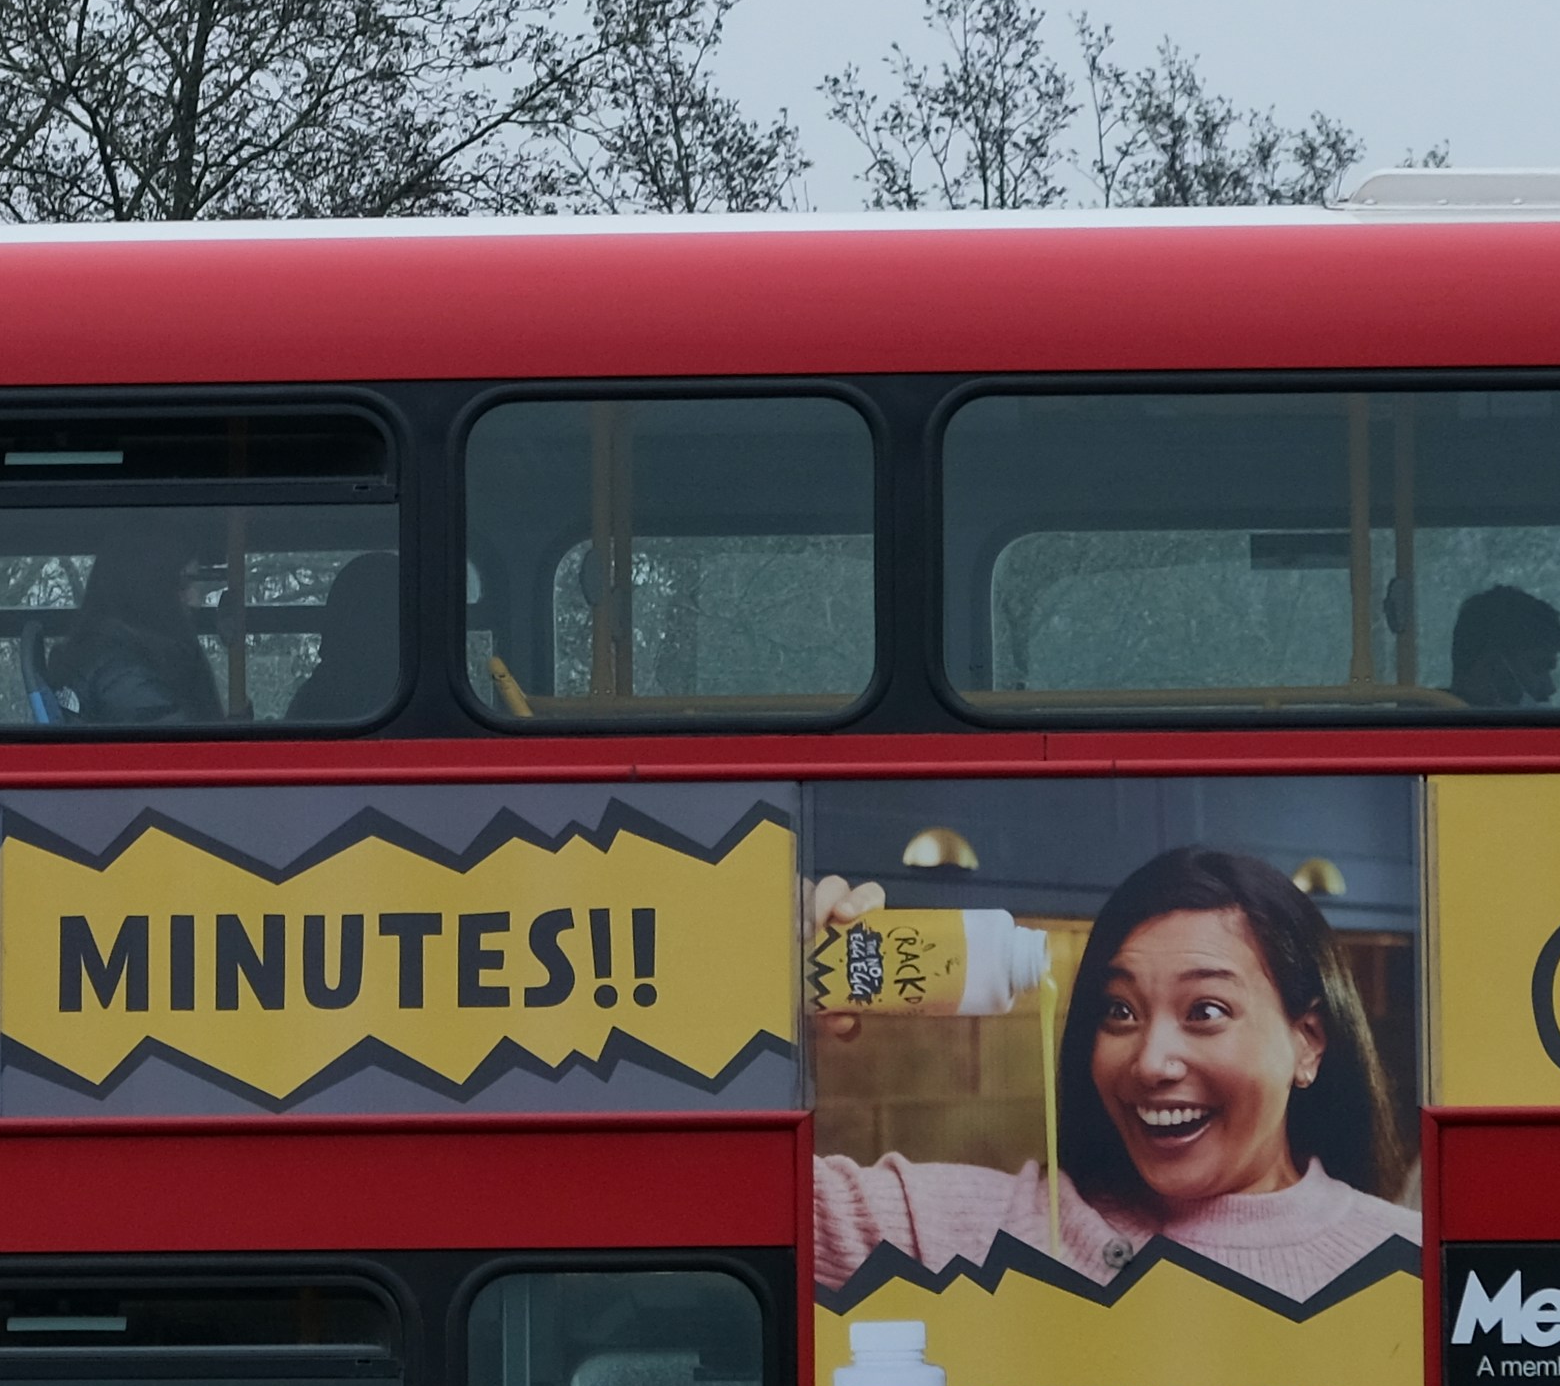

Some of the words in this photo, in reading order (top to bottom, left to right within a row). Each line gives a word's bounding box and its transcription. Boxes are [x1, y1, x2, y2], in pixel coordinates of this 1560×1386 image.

[56, 906, 660, 1014] MINUTES!!
[849, 962, 872, 996] EGG
[886, 925, 927, 1005] CRACKD
[1476, 1356, 1494, 1377] A
